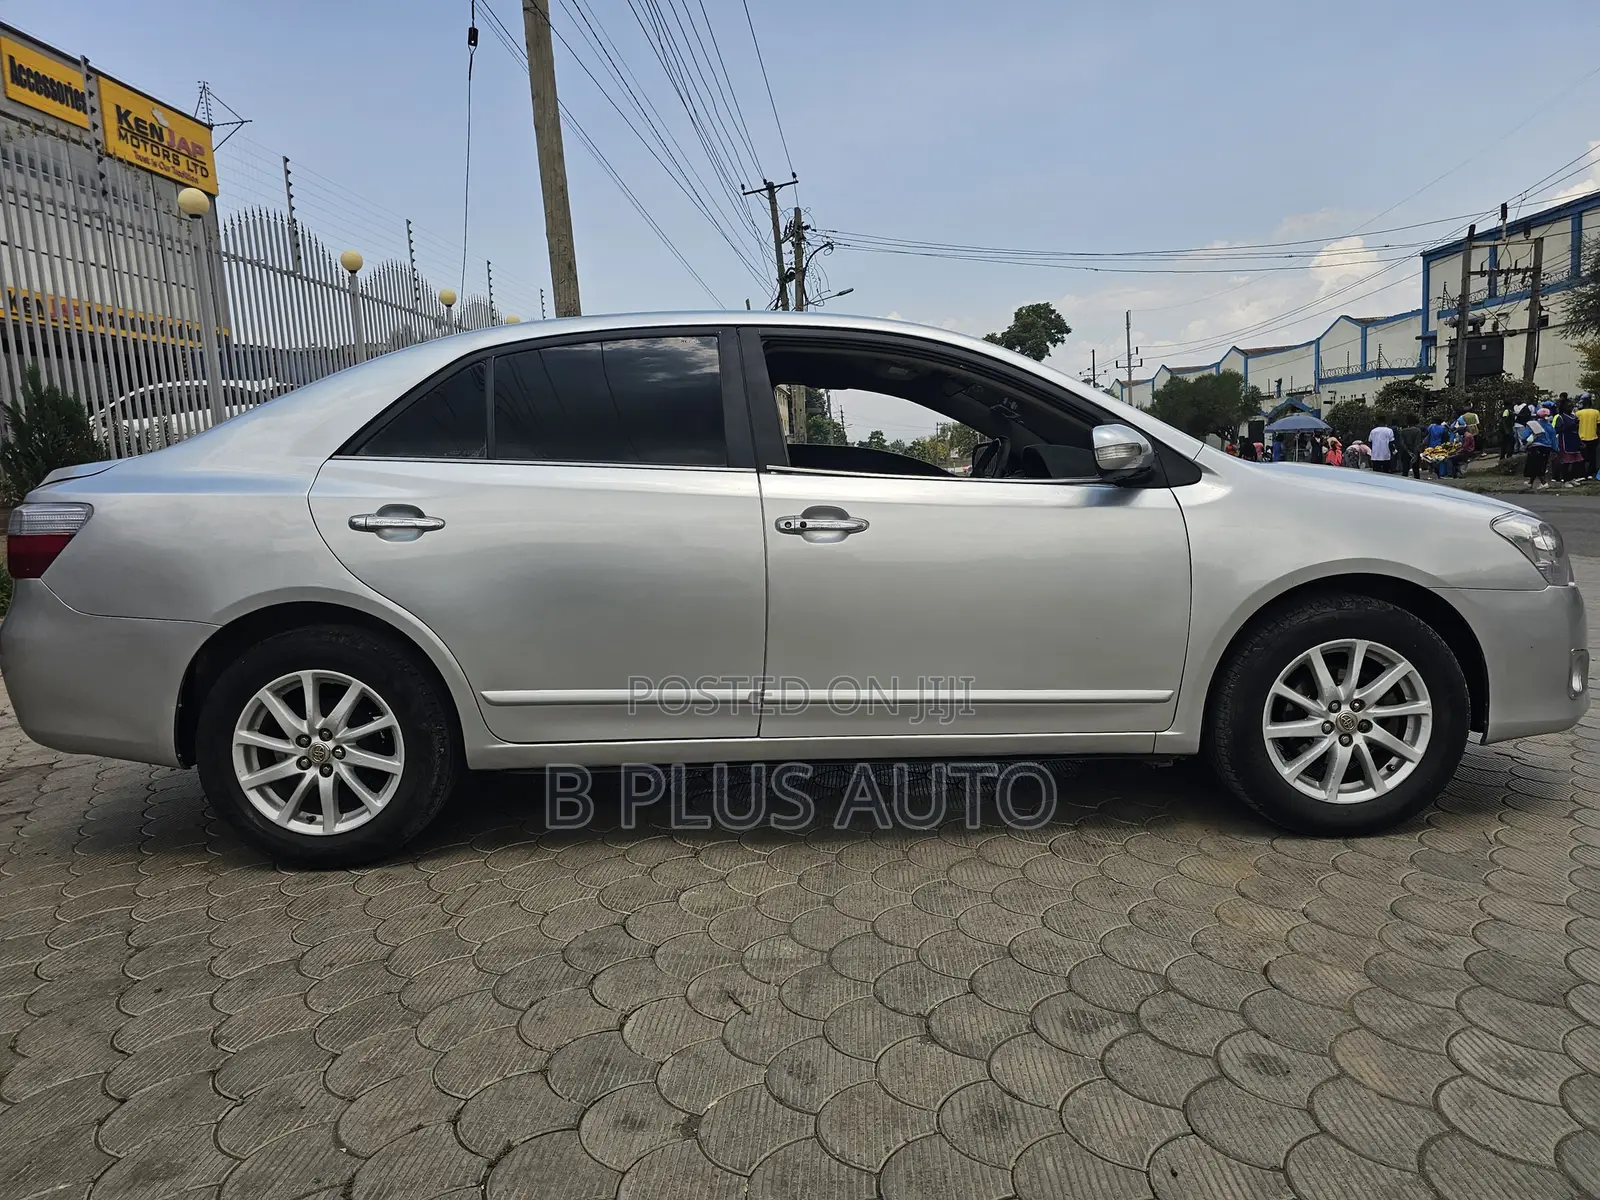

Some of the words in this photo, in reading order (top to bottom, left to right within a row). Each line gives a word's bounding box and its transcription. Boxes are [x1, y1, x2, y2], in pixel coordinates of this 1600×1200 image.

[115, 104, 205, 157] KENJAP
[118, 128, 181, 166] MOTORS
[186, 159, 209, 178] LTD
